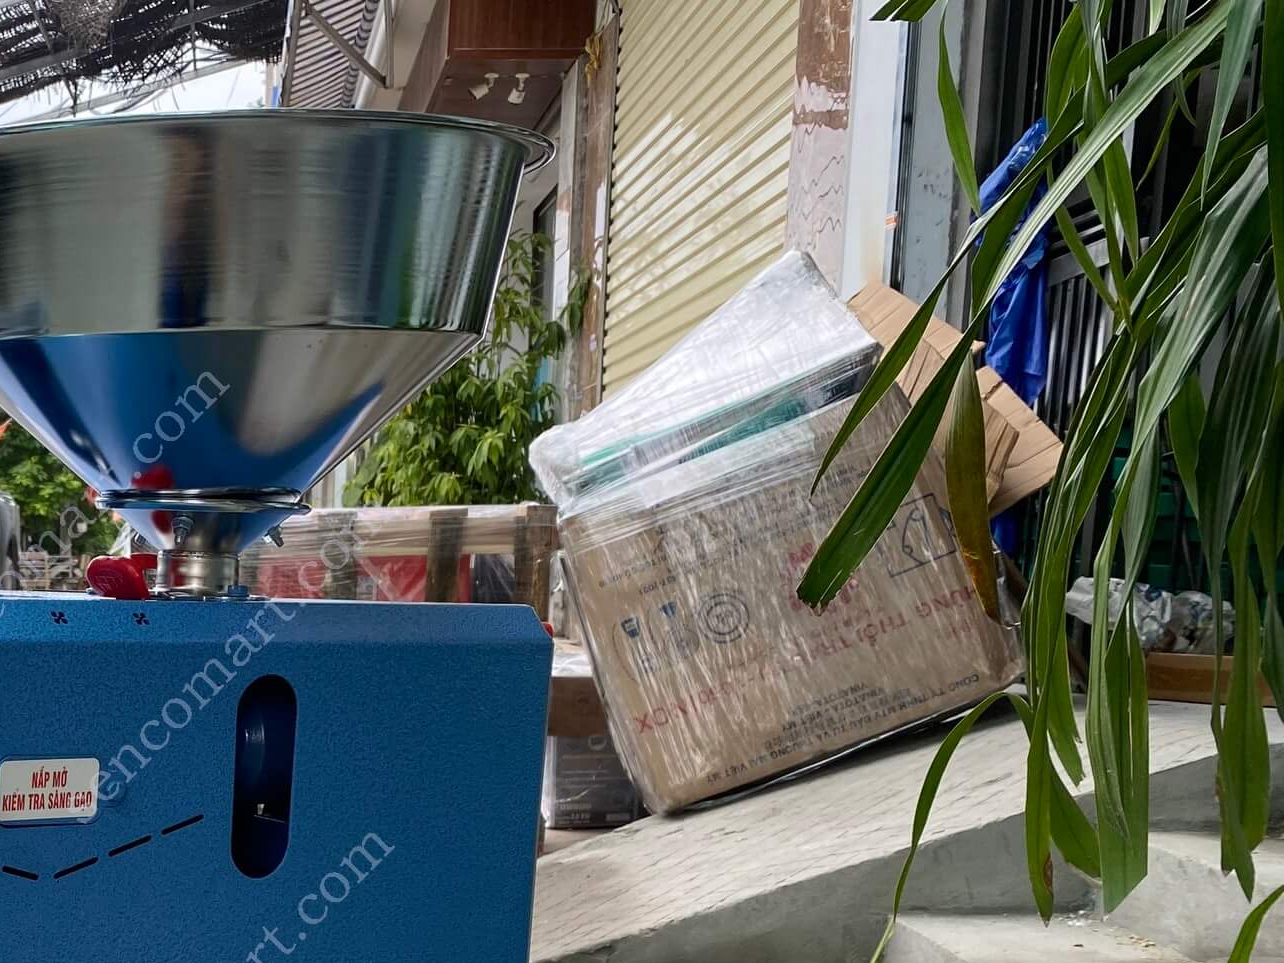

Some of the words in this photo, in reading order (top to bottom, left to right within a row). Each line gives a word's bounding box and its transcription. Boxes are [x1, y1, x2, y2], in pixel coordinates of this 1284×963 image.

[32, 766, 49, 788] NẮP
[52, 766, 68, 787] MỞ
[2, 788, 25, 811] KIỂM
[28, 793, 45, 810] TRA
[74, 791, 92, 811] GẠO
